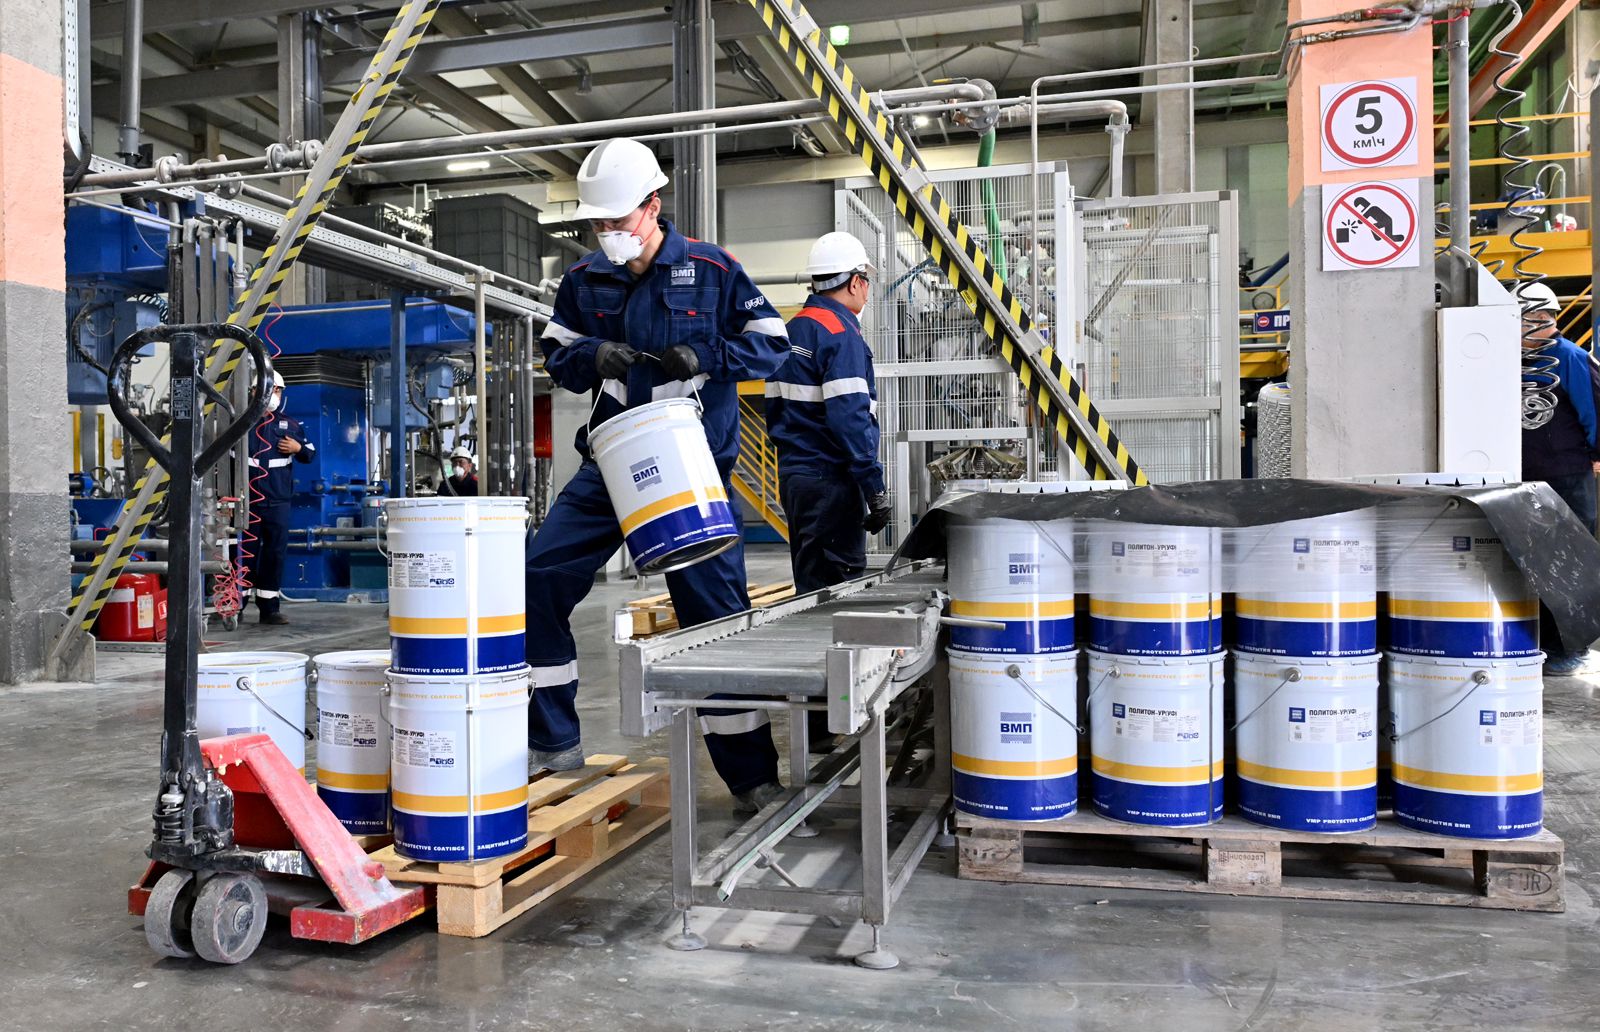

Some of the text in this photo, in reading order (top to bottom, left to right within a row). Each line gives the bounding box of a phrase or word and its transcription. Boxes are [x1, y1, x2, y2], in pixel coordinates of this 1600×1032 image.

[1355, 96, 1383, 135] 5
[671, 269, 695, 278] ВМП
[633, 466, 659, 483] ВМП
[1000, 723, 1032, 733] ВМП
